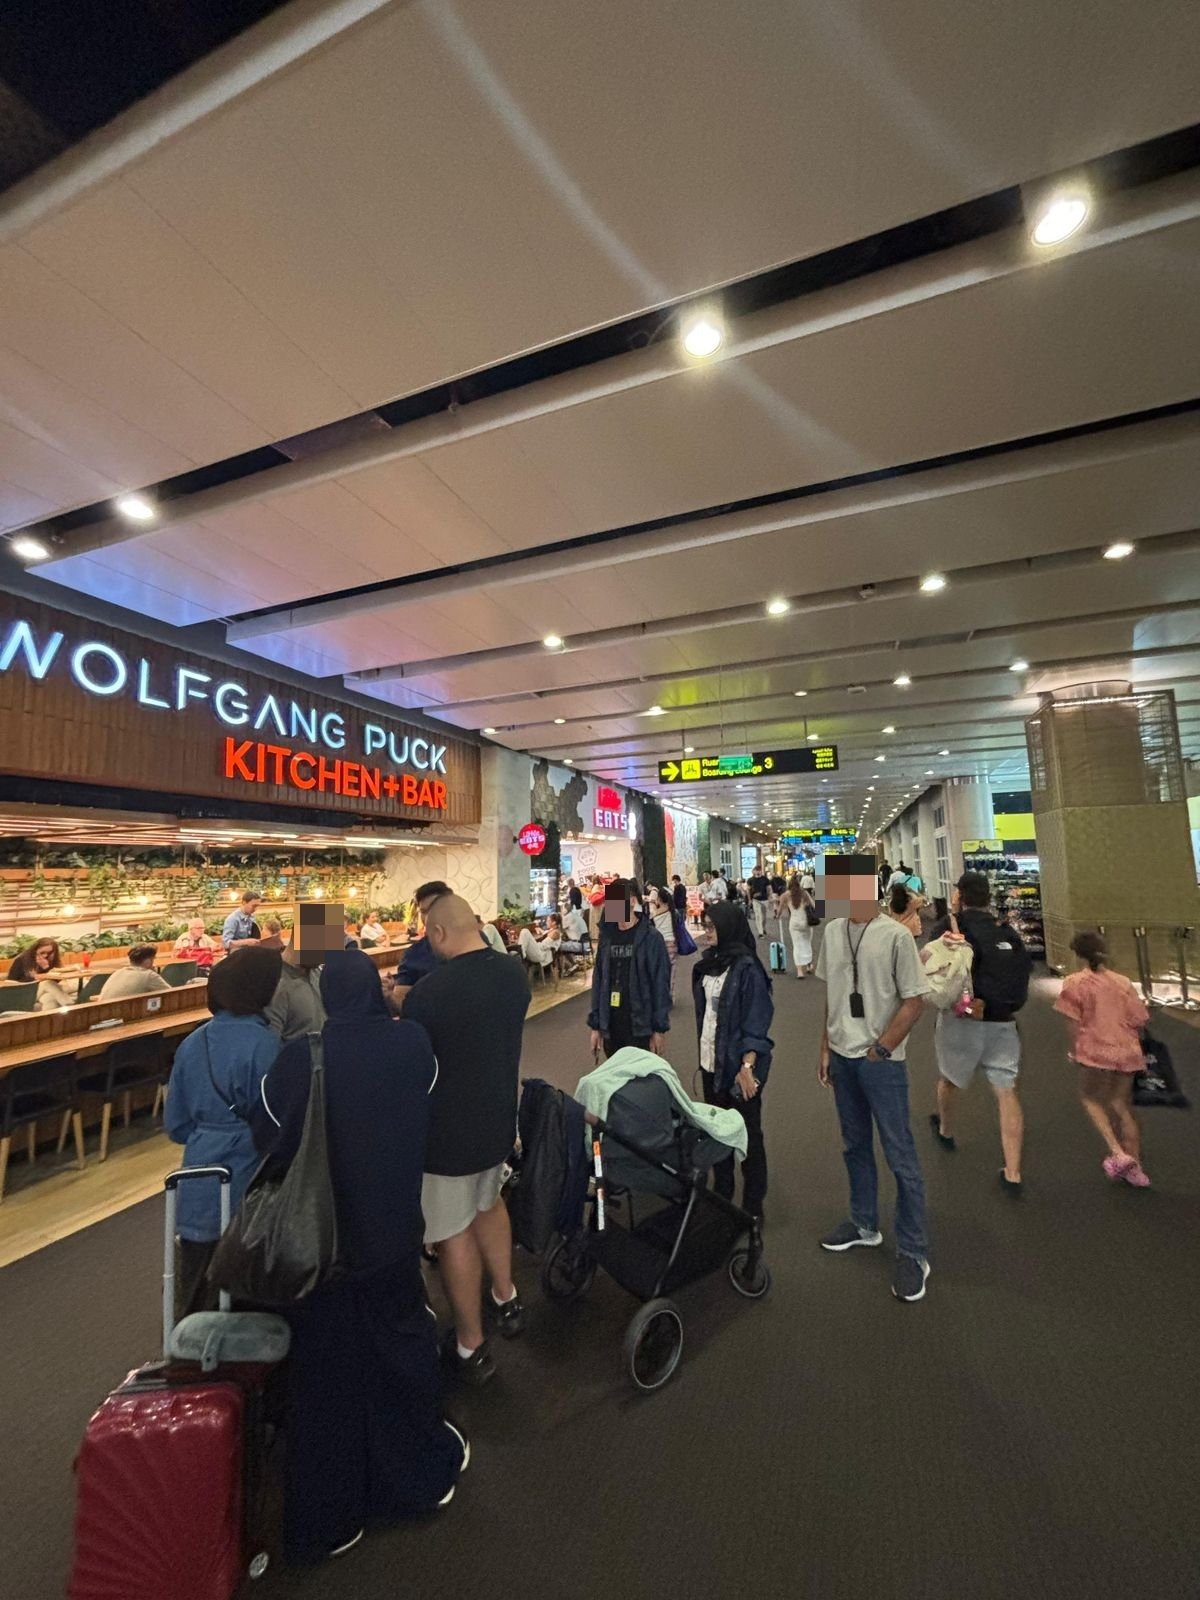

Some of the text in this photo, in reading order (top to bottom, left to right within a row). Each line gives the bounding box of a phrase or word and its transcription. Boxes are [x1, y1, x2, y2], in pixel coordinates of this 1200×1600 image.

[0, 620, 448, 774] WOLFGANG PUCK
[223, 737, 448, 810] KITCHEN+BAR
[764, 756, 773, 769] 3
[596, 809, 627, 831] EATS
